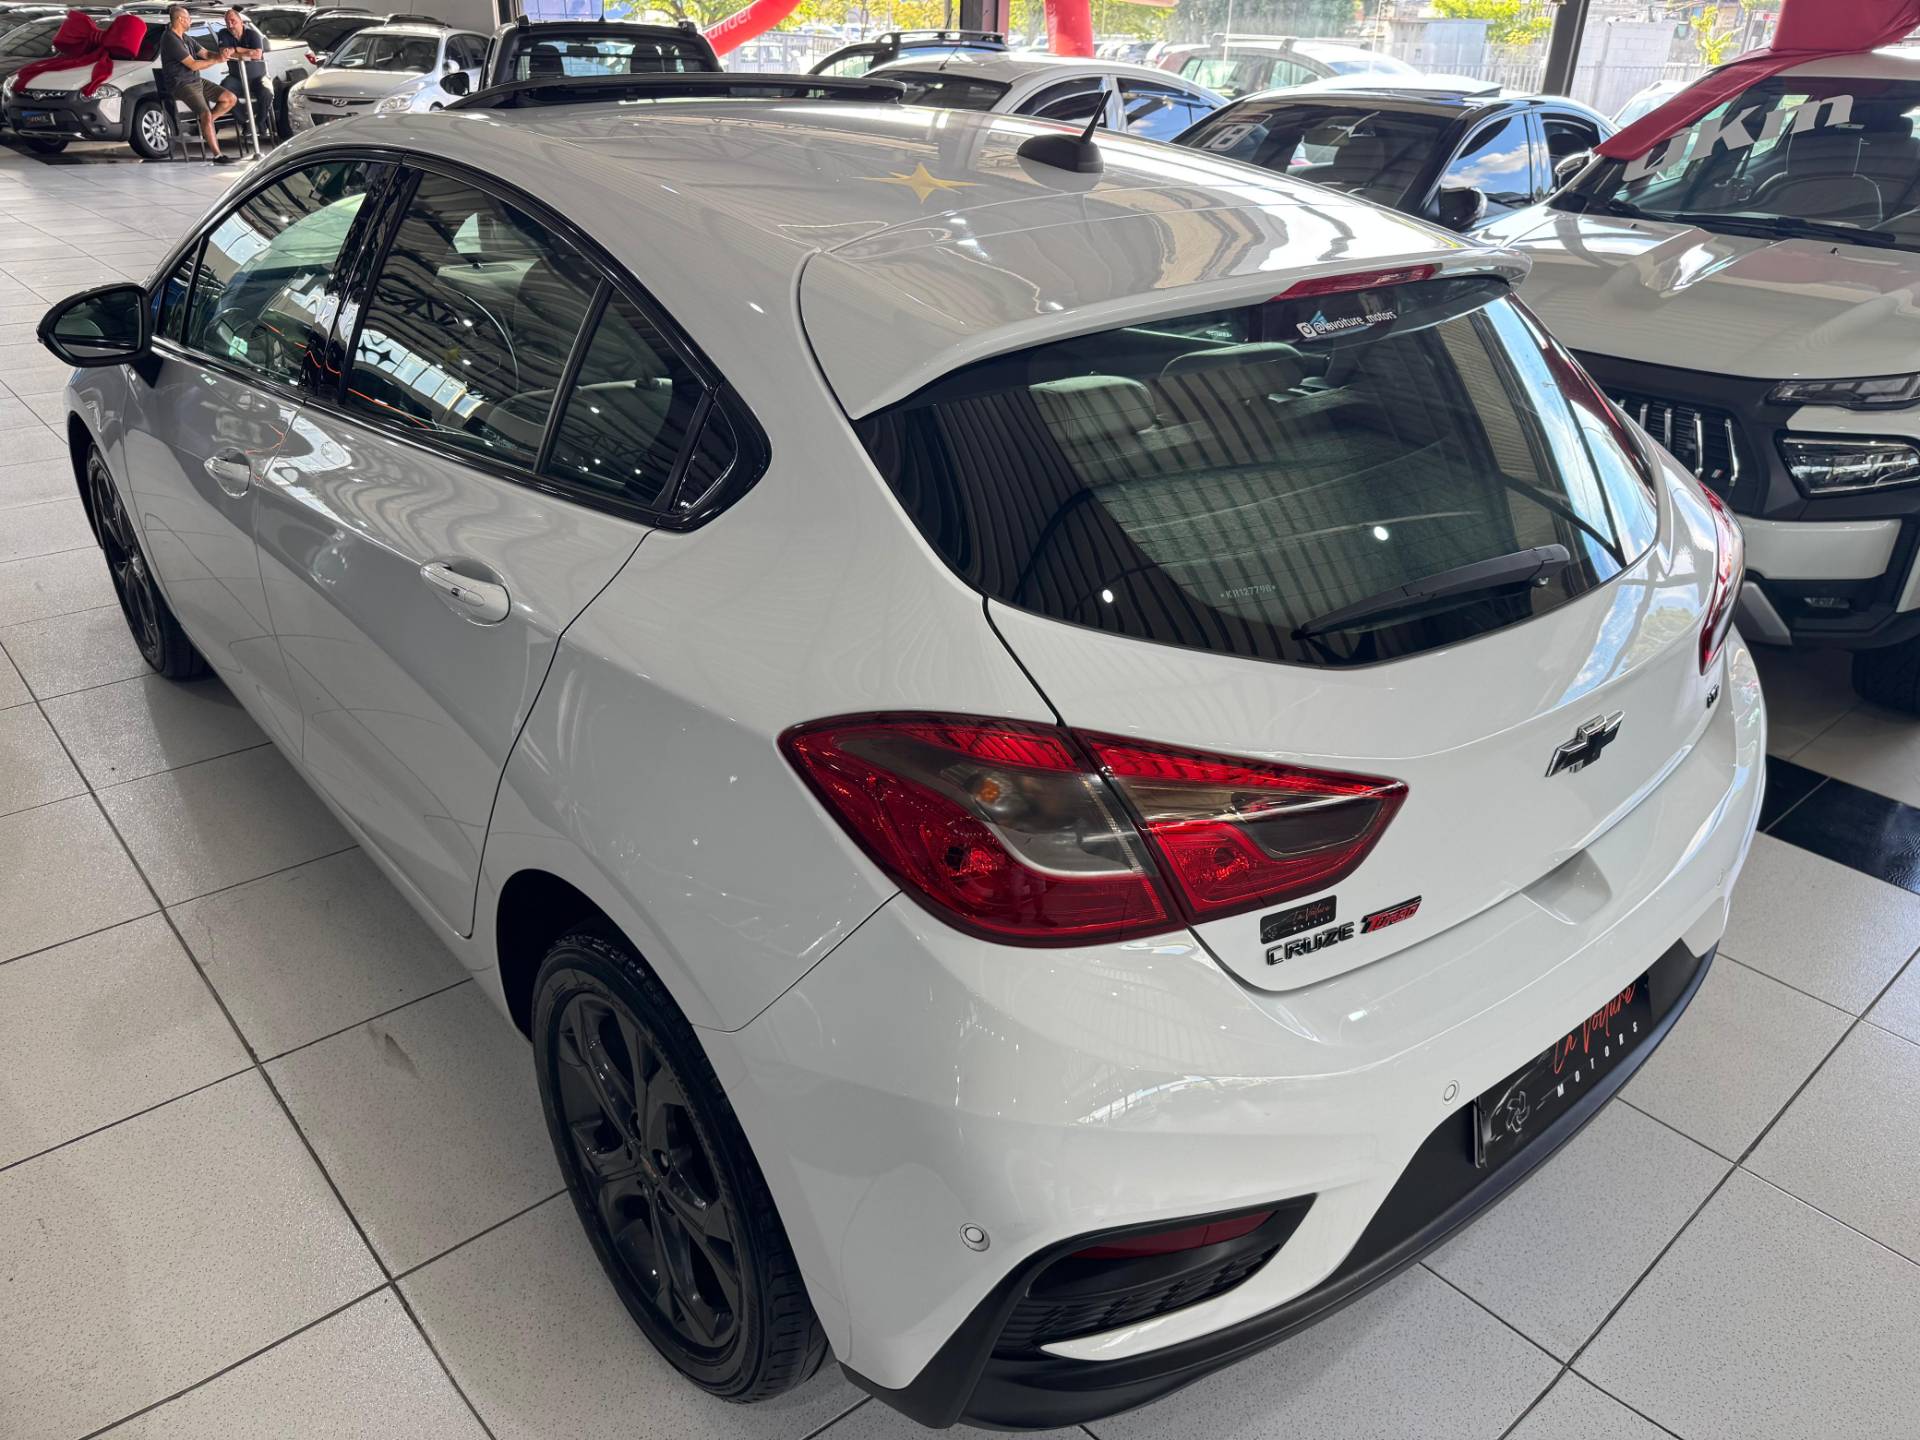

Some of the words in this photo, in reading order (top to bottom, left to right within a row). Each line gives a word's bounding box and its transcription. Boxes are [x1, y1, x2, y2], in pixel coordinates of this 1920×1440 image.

[1313, 311, 1398, 334] @lavoiture_motors
[1266, 921, 1355, 966] CRUZE
[1556, 1021, 1639, 1098] MOTORS
